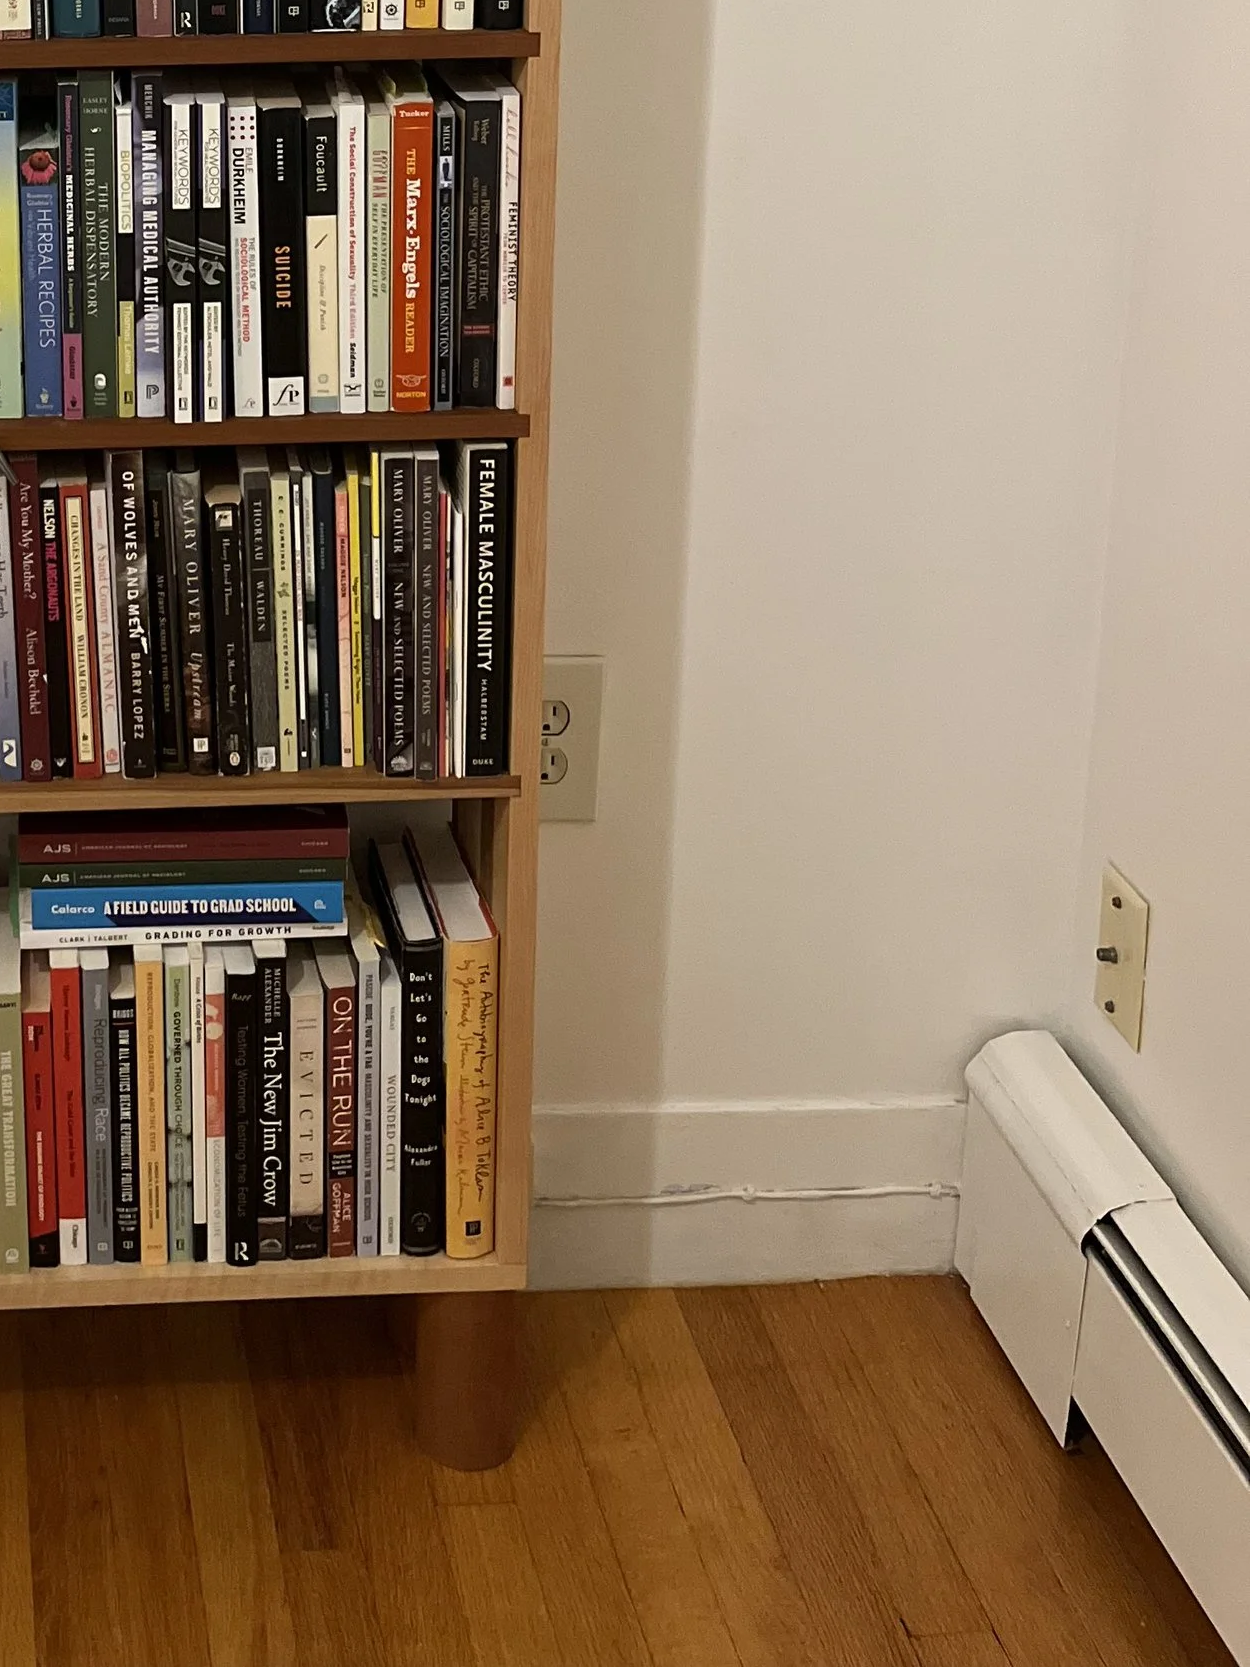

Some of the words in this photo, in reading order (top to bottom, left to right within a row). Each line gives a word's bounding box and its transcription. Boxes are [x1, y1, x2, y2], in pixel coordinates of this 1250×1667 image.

[141, 130, 157, 205] MANAGING
[233, 147, 246, 224] DURKHEIM
[315, 136, 328, 192] Foucault
[406, 148, 417, 175] THE
[142, 210, 158, 272] MEDICAL
[403, 178, 420, 299] Marx-Engels
[275, 246, 291, 309] SUICIDE
[144, 276, 160, 354] AUTHORITY
[405, 303, 416, 353] READER
[122, 471, 134, 490] OF
[479, 459, 495, 534] FEMALE
[124, 497, 137, 561] WOLVES
[182, 498, 197, 551] MARY
[253, 501, 263, 561] THOREAU
[125, 566, 138, 601] AND
[187, 561, 201, 635] OLIVER
[255, 581, 266, 632] WALDEN
[477, 541, 494, 671] MASCULINITY
[127, 604, 141, 638] MEN
[130, 653, 142, 694] BARRY
[133, 699, 144, 740] LOPEZ
[44, 844, 71, 853] AJS
[42, 873, 69, 883] AJS
[51, 905, 95, 914] Calarco
[104, 901, 112, 915] A
[113, 901, 148, 915] FIELD
[150, 900, 188, 914] GUIDE
[191, 900, 207, 913] TO
[210, 900, 243, 913] GRAD
[246, 898, 296, 913] SCHOOL
[145, 930, 202, 939] GRADING
[209, 929, 232, 938] FOR
[239, 927, 292, 936] GROWTH
[264, 968, 273, 1024] ALEXANDER
[273, 968, 281, 1017] MICHELLE
[333, 996, 352, 1034] ON
[263, 1032, 282, 1068] The
[333, 1040, 352, 1087] THE
[263, 1074, 280, 1115] New
[299, 1050, 313, 1185] EVICTED
[259, 1119, 281, 1151] Jim
[333, 1095, 352, 1145] RUN
[263, 1157, 281, 1206] Crow
